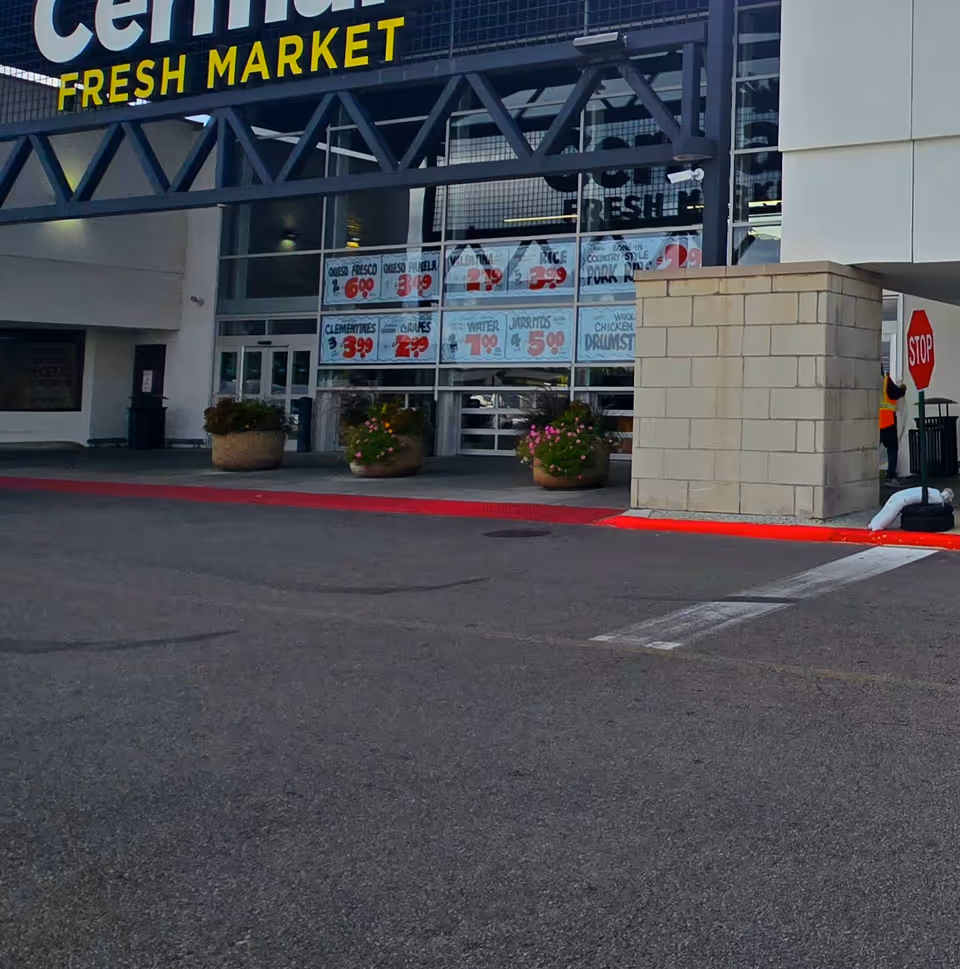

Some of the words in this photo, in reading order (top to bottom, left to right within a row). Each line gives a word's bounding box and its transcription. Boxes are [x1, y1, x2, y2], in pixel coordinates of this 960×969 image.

[57, 55, 187, 111] FRESH
[207, 17, 405, 89] MARKET
[540, 250, 567, 265] RICE
[352, 263, 377, 276] FRESCO
[383, 262, 406, 274] QUESO
[586, 263, 618, 285] PORK
[325, 322, 376, 335] CLEMENTINES
[467, 320, 500, 332] WATER
[508, 315, 552, 330] JARRITOS
[594, 322, 634, 332] CHICKEN
[909, 334, 932, 367] STOP
